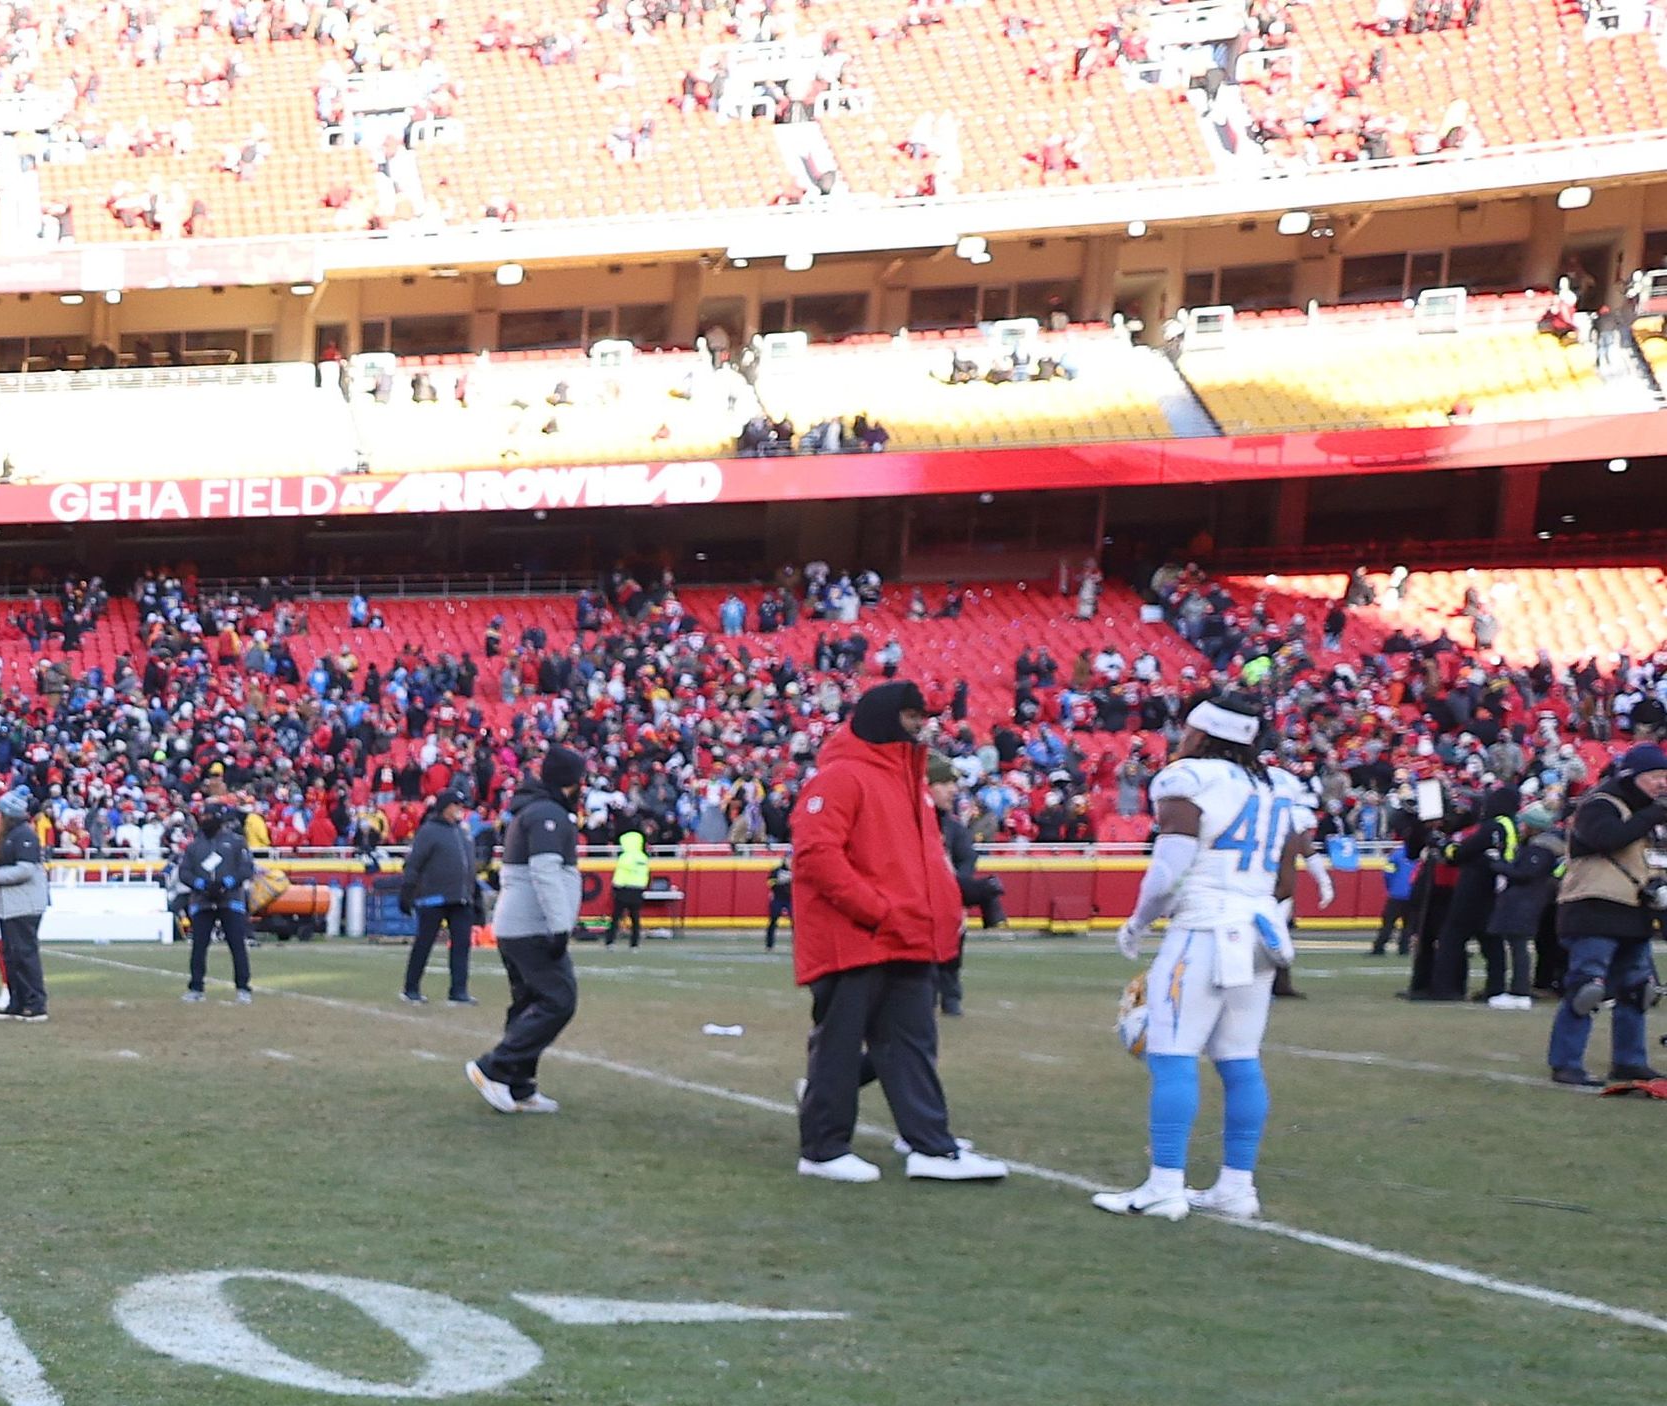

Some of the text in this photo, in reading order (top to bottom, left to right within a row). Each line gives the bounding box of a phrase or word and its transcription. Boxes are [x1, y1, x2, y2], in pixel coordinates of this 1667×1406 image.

[49, 460, 724, 523] GEHA FIELD AT ARROWHEAD
[1213, 794, 1293, 873] 40
